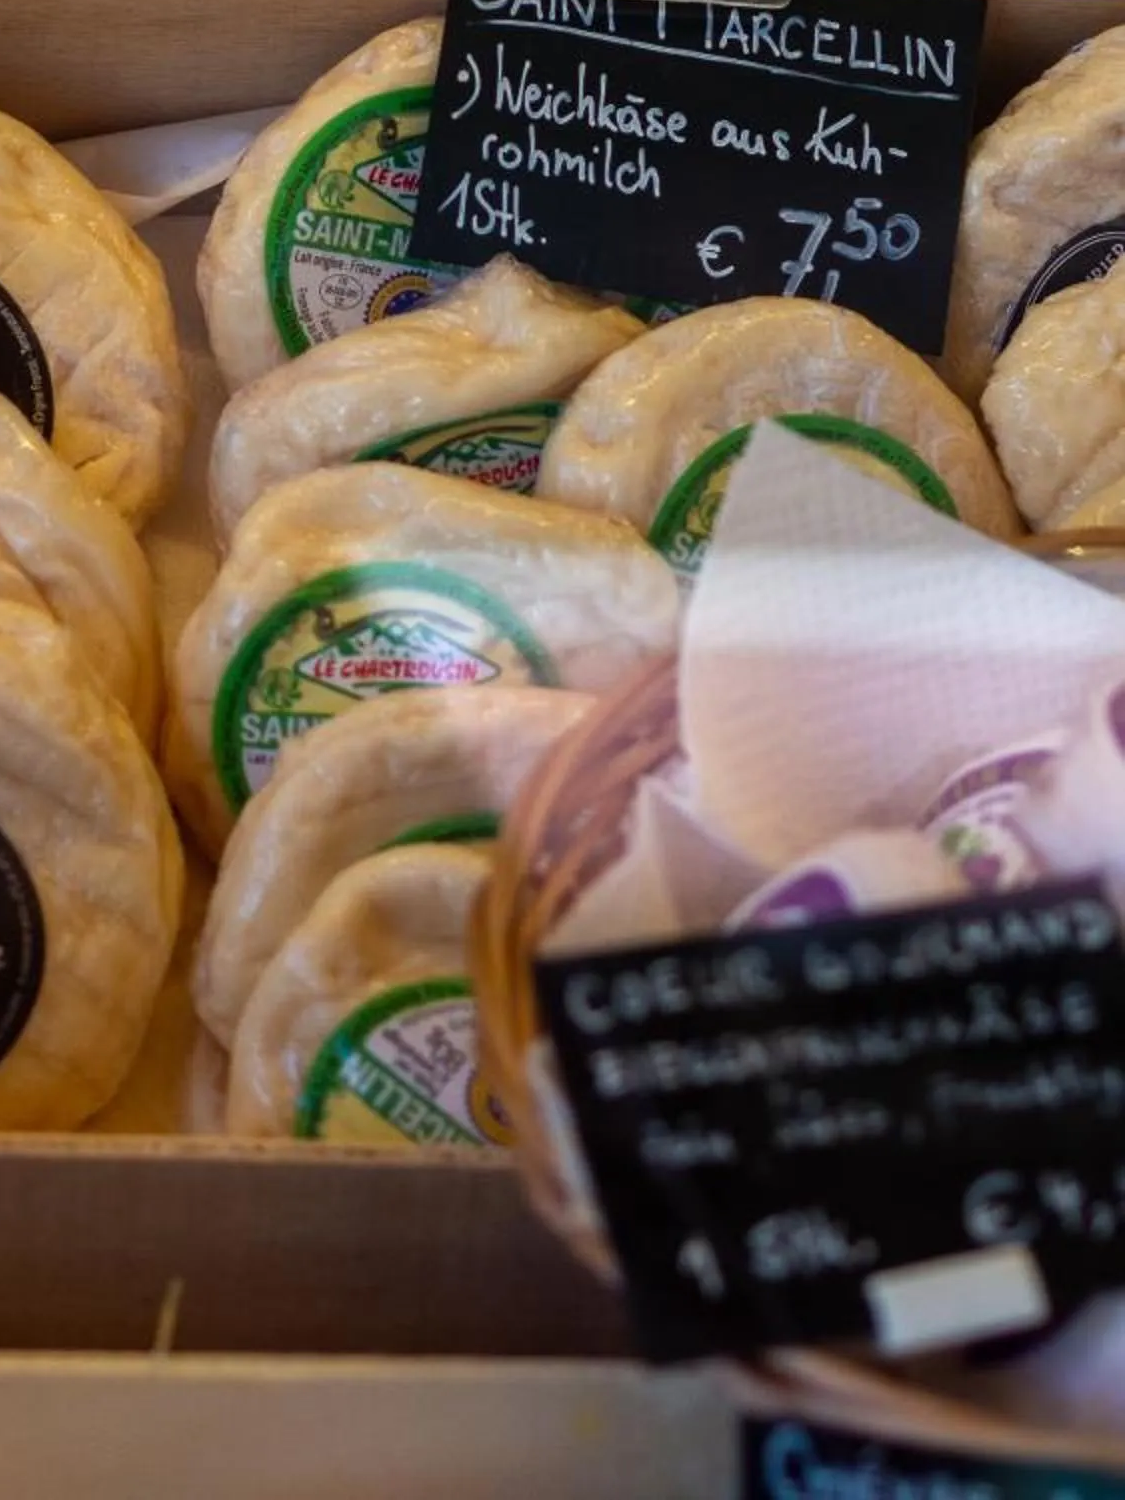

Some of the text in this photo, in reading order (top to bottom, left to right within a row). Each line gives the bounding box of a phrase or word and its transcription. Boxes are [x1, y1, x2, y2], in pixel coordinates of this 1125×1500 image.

[496, 43, 909, 175] Weichkäse aus Kuh-
[481, 126, 661, 198] rohmilch
[695, 225, 743, 277] €
